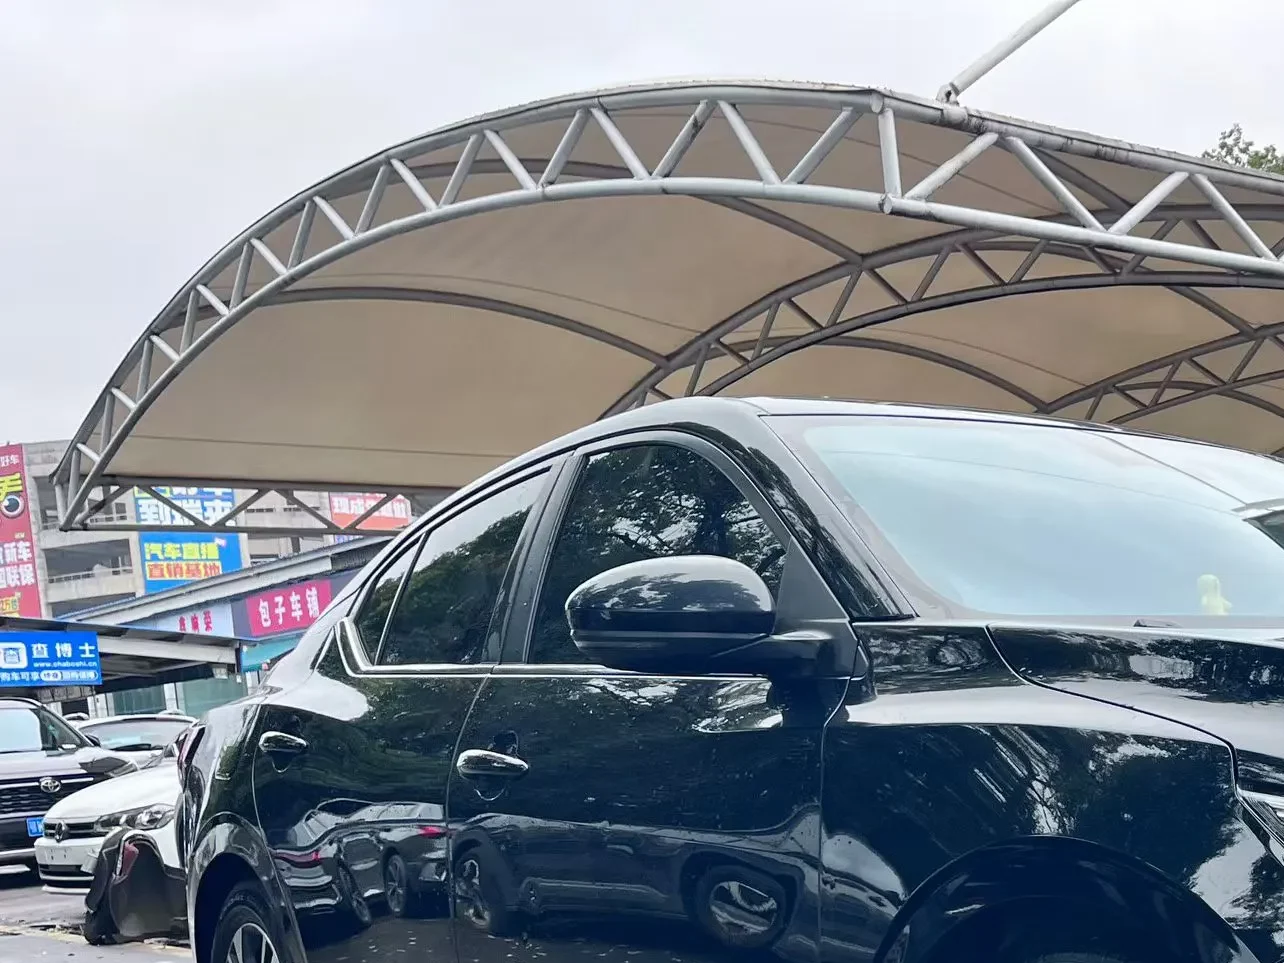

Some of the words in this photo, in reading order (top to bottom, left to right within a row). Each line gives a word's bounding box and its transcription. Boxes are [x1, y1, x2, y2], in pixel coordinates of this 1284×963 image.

[0, 541, 33, 564] 新车
[258, 587, 320, 628] 包子车铺
[31, 642, 96, 659] 查博士
